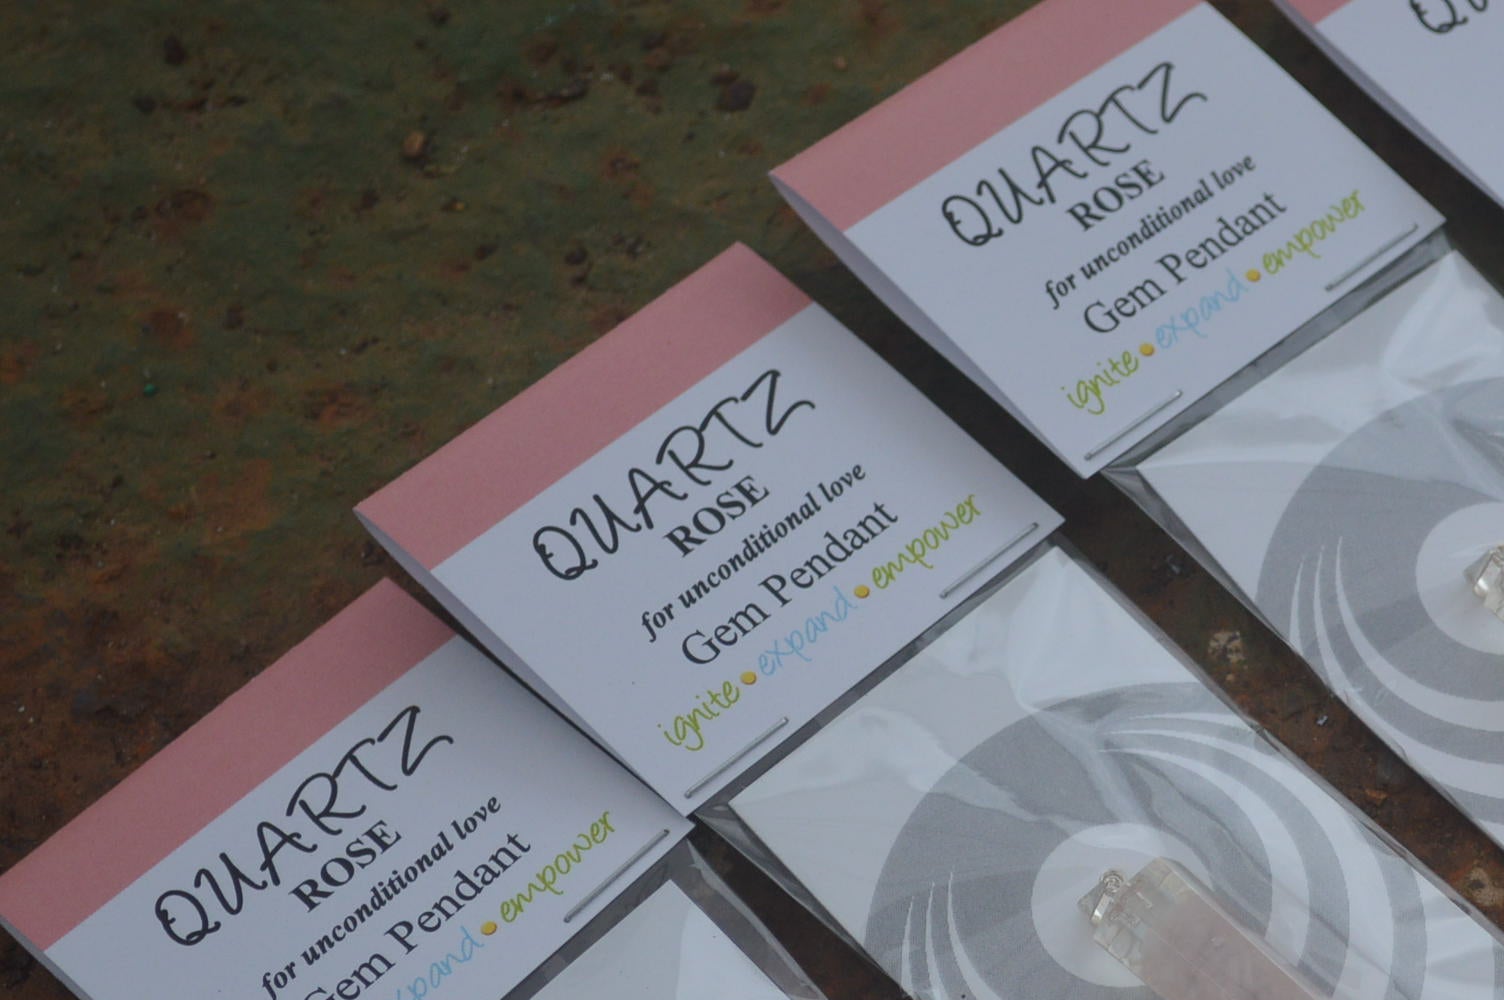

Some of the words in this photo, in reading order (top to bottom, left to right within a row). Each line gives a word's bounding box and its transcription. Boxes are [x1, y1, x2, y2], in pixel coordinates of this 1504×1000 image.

[942, 62, 1208, 246] QUARTZ
[1044, 279, 1080, 310] for
[1083, 179, 1215, 282] unconditional
[1211, 155, 1257, 191] love
[1066, 160, 1165, 232] ROSE
[1062, 350, 1139, 415] ignite
[1156, 271, 1248, 350] expand
[1262, 190, 1366, 276] empower
[1083, 279, 1168, 333] Gem
[1155, 192, 1287, 285] Pendant
[532, 369, 816, 581] QUARTZ
[641, 610, 675, 642] for
[680, 498, 821, 609] unconditional
[817, 463, 866, 503] love
[662, 476, 770, 557] ROSE
[657, 680, 741, 751] ignite
[758, 586, 858, 677] expand
[871, 493, 983, 589] empower
[681, 604, 771, 665] Gem
[758, 501, 899, 608] Pendant
[154, 705, 454, 946] QUARTZ
[288, 820, 402, 913] ROSE
[301, 837, 454, 967] unconditional
[450, 796, 502, 839] love
[384, 831, 531, 955] Pendant
[500, 810, 616, 924] empower
